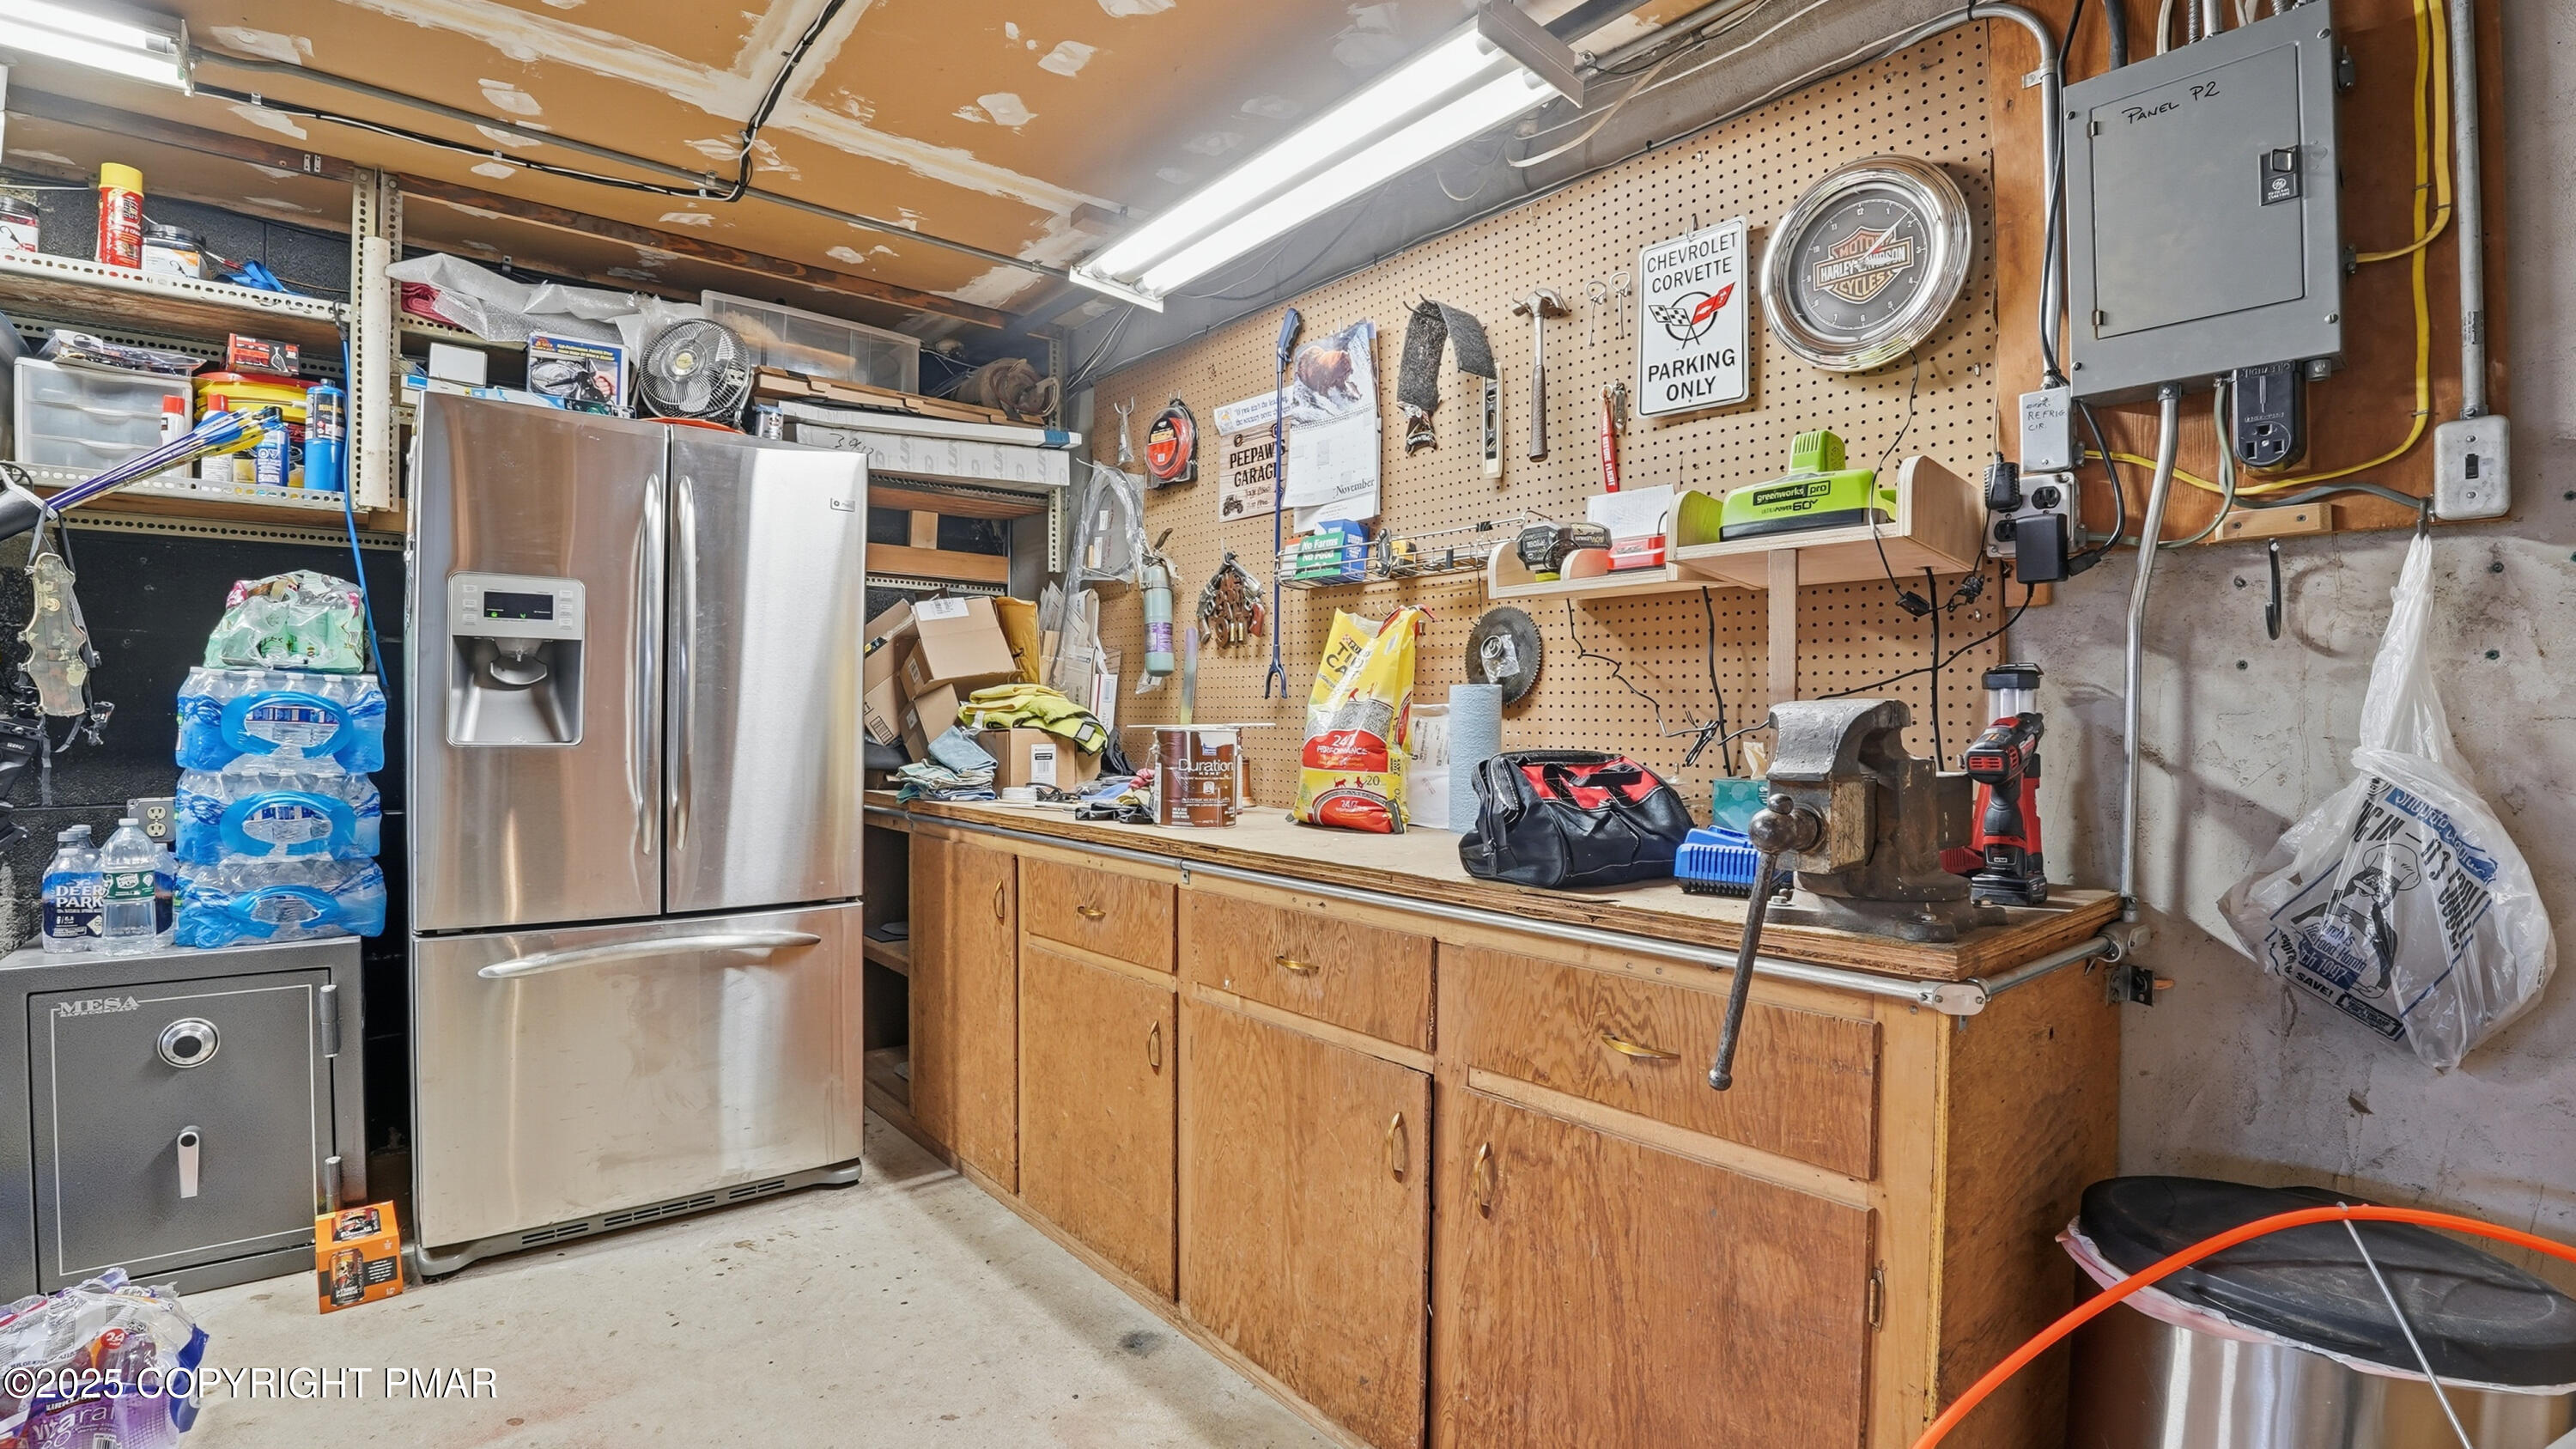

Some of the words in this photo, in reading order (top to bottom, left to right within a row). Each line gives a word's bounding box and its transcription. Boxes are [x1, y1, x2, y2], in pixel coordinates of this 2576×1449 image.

[2121, 102, 2180, 124] PANEL
[2189, 81, 2221, 101] P2
[1648, 231, 1737, 272] CHEVROLET
[1652, 256, 1732, 293] CORVETTE
[1839, 272, 1885, 296] CYCLES
[1649, 349, 1735, 382] PARKING
[1666, 375, 1716, 401] ONLY
[1230, 439, 1285, 469] PEEPAWS
[1605, 462, 1615, 486] FLIGHT
[1334, 478, 1375, 496] November
[1756, 487, 1805, 504] greenworks
[1809, 484, 1827, 495] pro
[1302, 540, 1313, 551] No
[1314, 538, 1339, 550] Farms
[1178, 759, 1234, 773] Duration
[1366, 776, 1380, 786] 20
[55, 885, 103, 897] DEER
[55, 896, 104, 909] PARK
[2318, 957, 2348, 982] 1997
[2295, 971, 2334, 999] SAVE!
[58, 996, 141, 1014] MESA
[106, 1331, 125, 1343] 24
[32, 1405, 116, 1441] vitara
